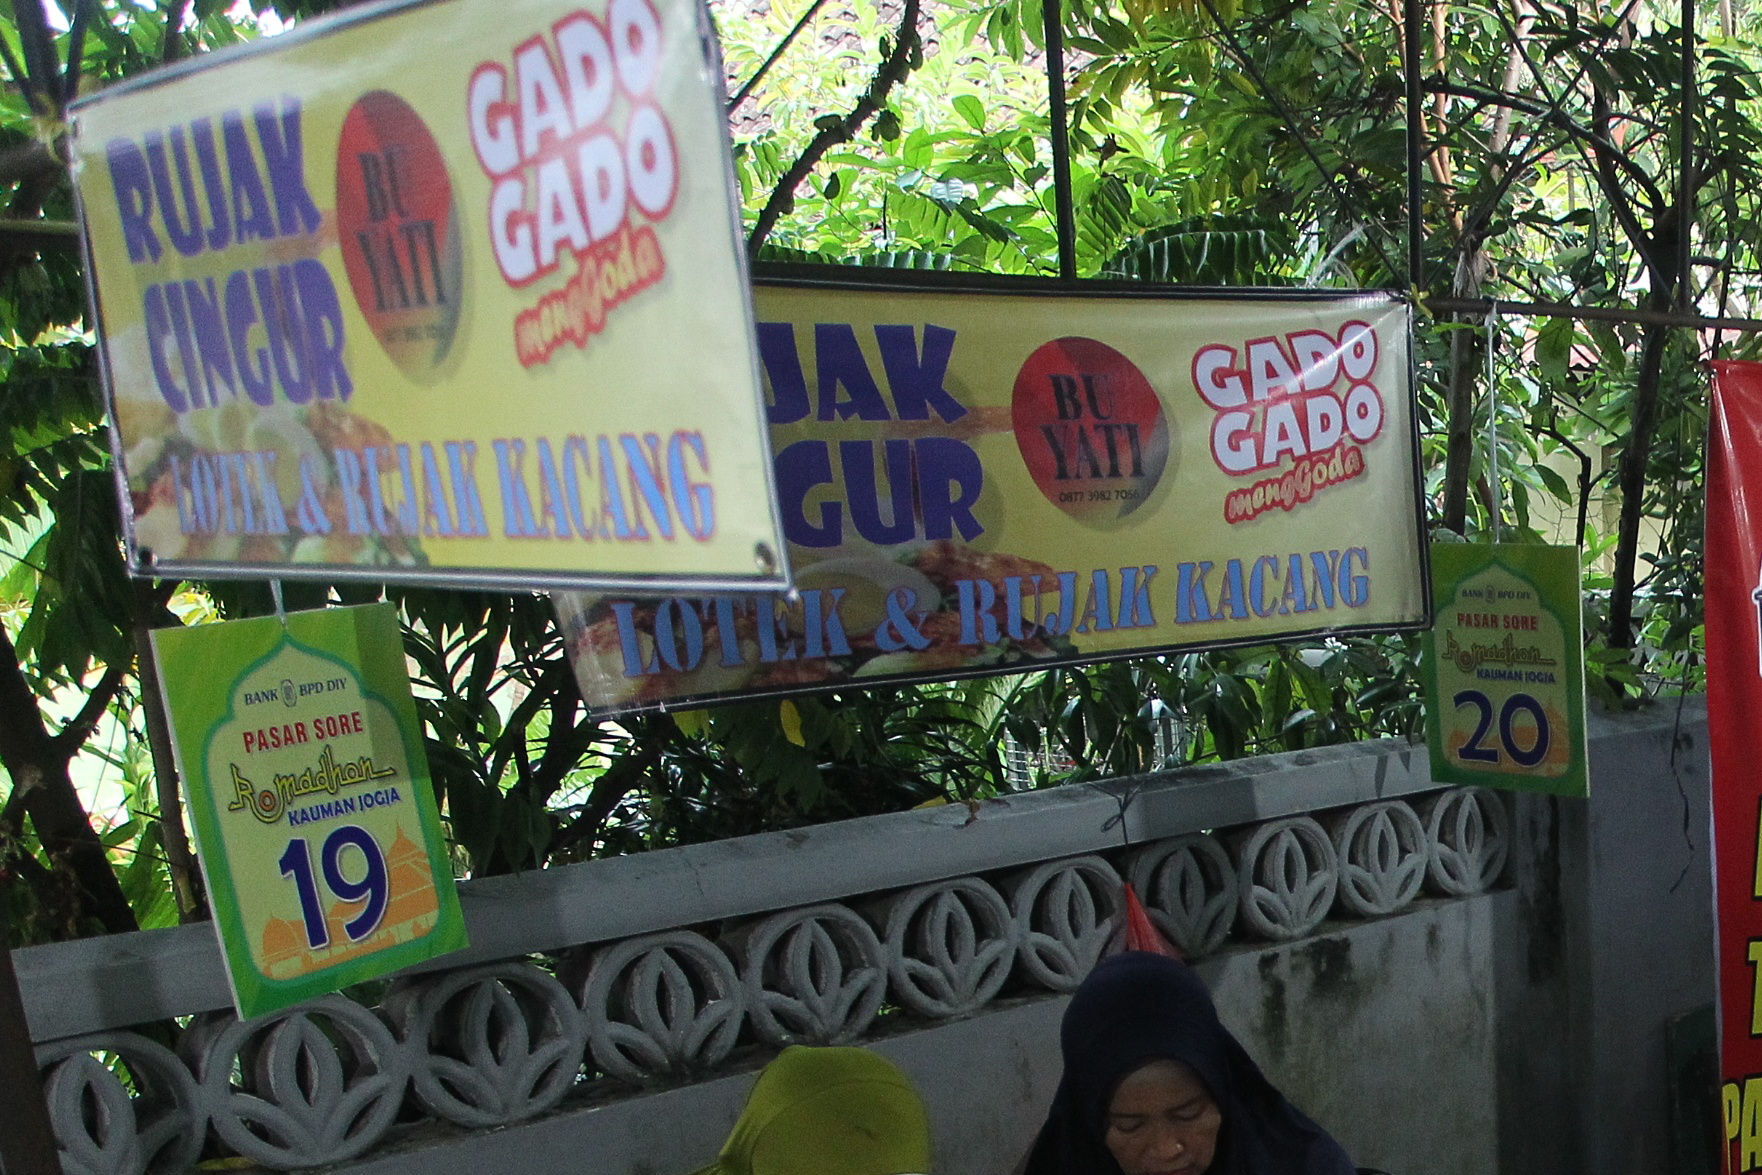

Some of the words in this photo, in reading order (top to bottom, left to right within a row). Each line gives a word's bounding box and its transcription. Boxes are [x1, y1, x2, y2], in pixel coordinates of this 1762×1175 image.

[467, 0, 662, 180] GADO
[105, 93, 321, 265] RUJAK
[488, 100, 680, 287] GADO
[144, 258, 354, 413] CINGUR
[756, 322, 968, 424] JAK
[1193, 320, 1378, 410] GADO
[1049, 373, 1115, 420] BU
[1211, 382, 1384, 475] GADO
[168, 452, 288, 535] LOTEK
[332, 442, 488, 537] RUJAK
[492, 428, 716, 542] KACANG
[774, 437, 985, 548] GUR
[1040, 423, 1146, 480] YATI
[610, 587, 853, 678] LOTEK
[875, 585, 931, 652] &
[955, 565, 1158, 646] RUJAK
[1175, 547, 1369, 625] KACANG
[1457, 612, 1499, 629] PASAR
[1503, 614, 1538, 631] SORE
[244, 688, 278, 706] BANK
[299, 681, 324, 697] BPD
[326, 677, 348, 694] DIY
[1476, 667, 1522, 682] KAUMAN
[1524, 670, 1556, 685] JOGJA
[243, 721, 309, 753] PASAR
[314, 711, 364, 740] SORE
[1453, 689, 1550, 767] 20
[288, 797, 356, 826] KAUMAN
[359, 786, 400, 814] JOGJA
[279, 825, 389, 949] 19
